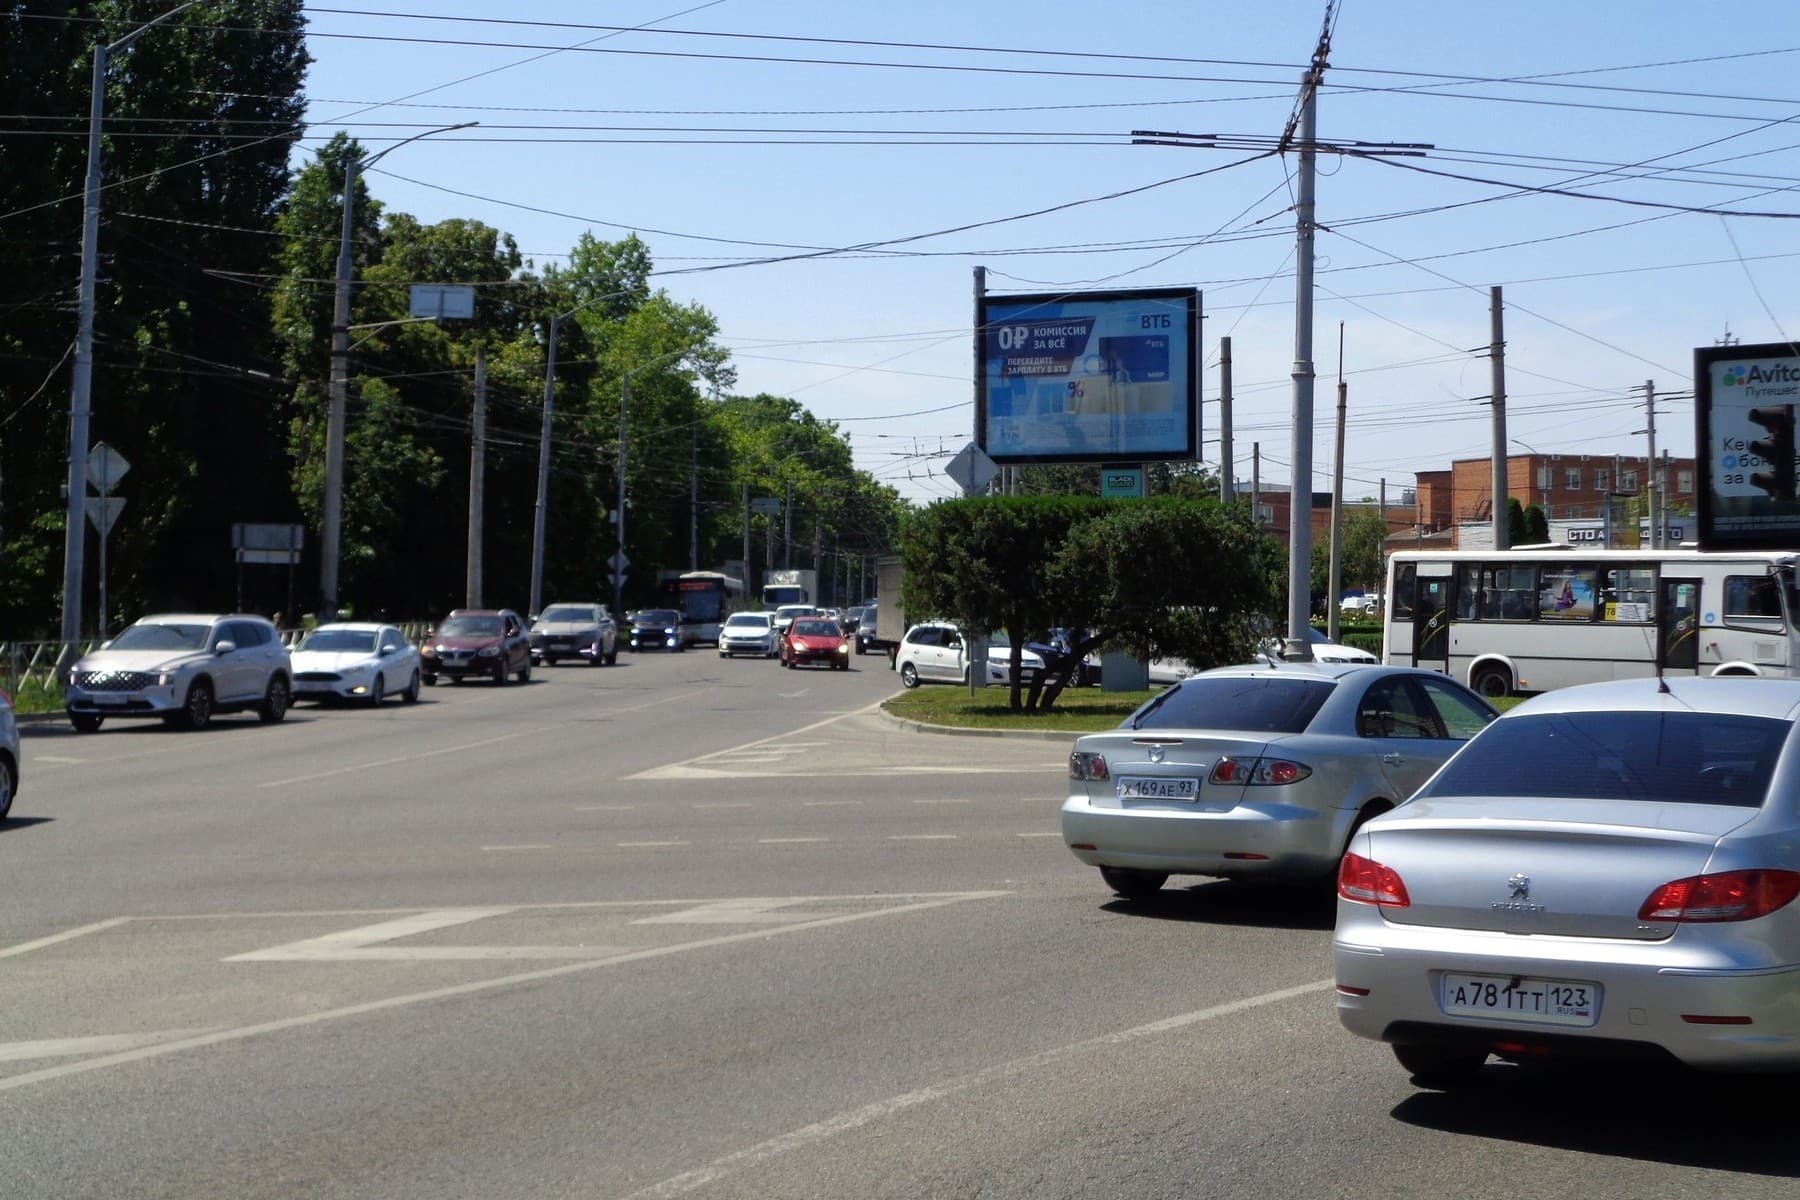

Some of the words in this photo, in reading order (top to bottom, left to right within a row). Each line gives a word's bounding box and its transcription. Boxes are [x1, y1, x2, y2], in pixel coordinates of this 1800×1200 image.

[1141, 314, 1171, 328] ВТБ
[1033, 326, 1086, 337] КОМИССИЯ
[1033, 340, 1046, 349] ЗА
[1048, 337, 1065, 348] ВСЁ
[1723, 474, 1744, 484] за
[1568, 530, 1595, 540] СТО
[1606, 607, 1616, 616] 78
[1551, 988, 1586, 1007] 123
[1557, 1007, 1575, 1016] RUS
